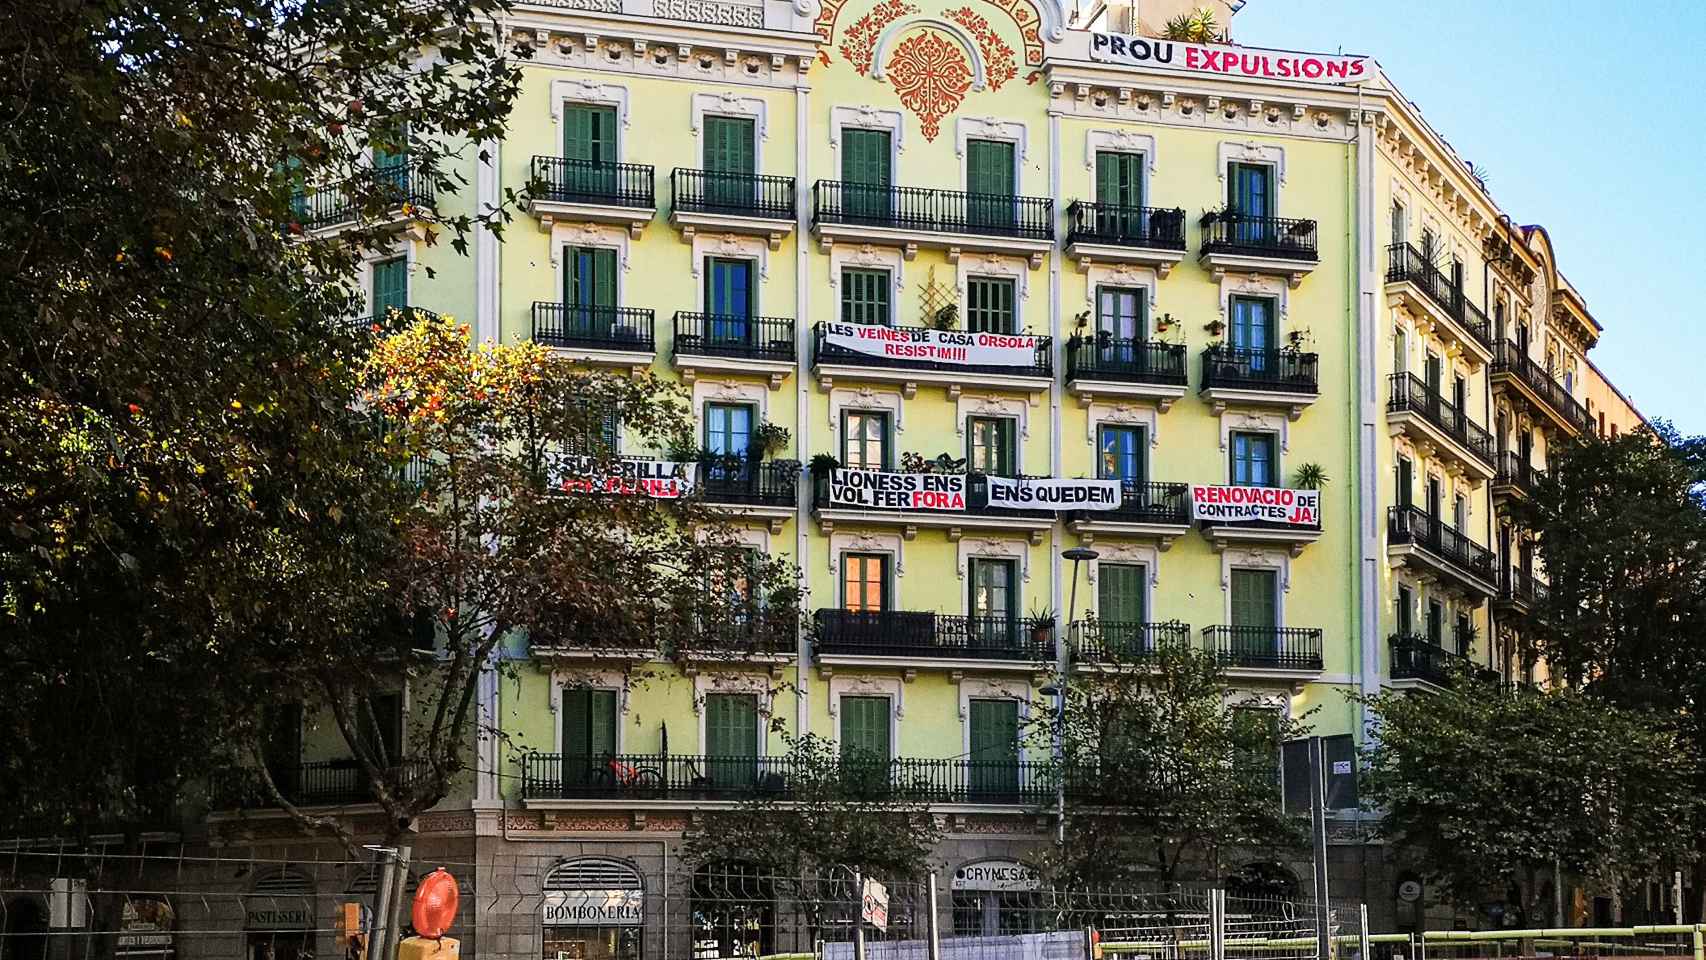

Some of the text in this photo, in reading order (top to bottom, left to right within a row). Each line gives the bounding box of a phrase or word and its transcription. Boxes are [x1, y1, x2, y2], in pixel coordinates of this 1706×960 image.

[1093, 32, 1365, 79] PROU EXPULSIONS
[827, 322, 854, 337] LES
[911, 330, 930, 343] DE
[938, 332, 975, 347] CASA
[978, 334, 1034, 349] ORSOLA
[830, 468, 963, 492] LIONESS ENS
[832, 485, 965, 510] VOL FER FORA
[991, 484, 1116, 505] ENS QUEDEM
[1297, 495, 1317, 508] DE
[1198, 503, 1318, 524] CONTRACTES JA!
[966, 867, 1026, 881] CRYMESA
[546, 905, 640, 919] BOMBONERIA
